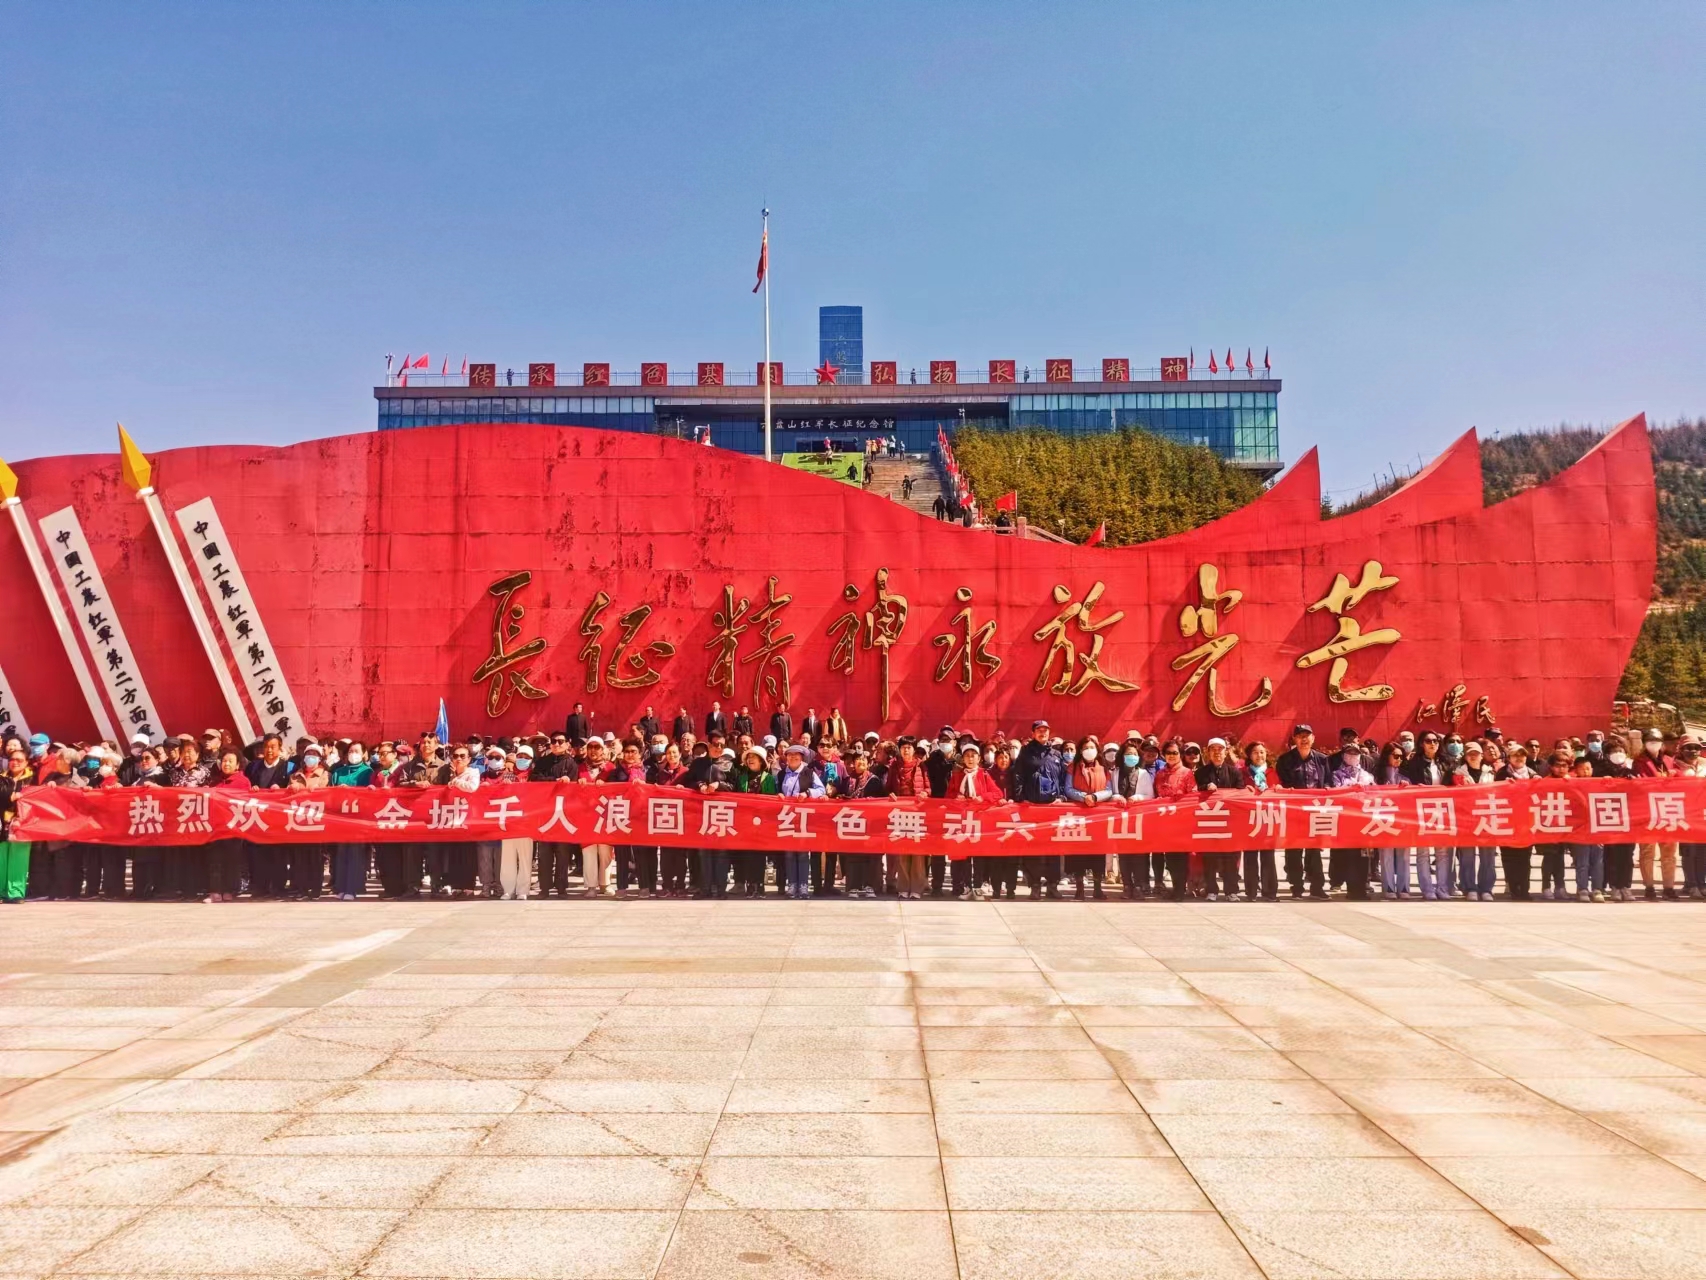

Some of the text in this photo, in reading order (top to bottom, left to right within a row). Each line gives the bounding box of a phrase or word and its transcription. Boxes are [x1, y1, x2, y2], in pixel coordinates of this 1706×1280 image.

[472, 363, 779, 386] 传承红色基因
[874, 360, 1186, 383] 弘扬长征精神
